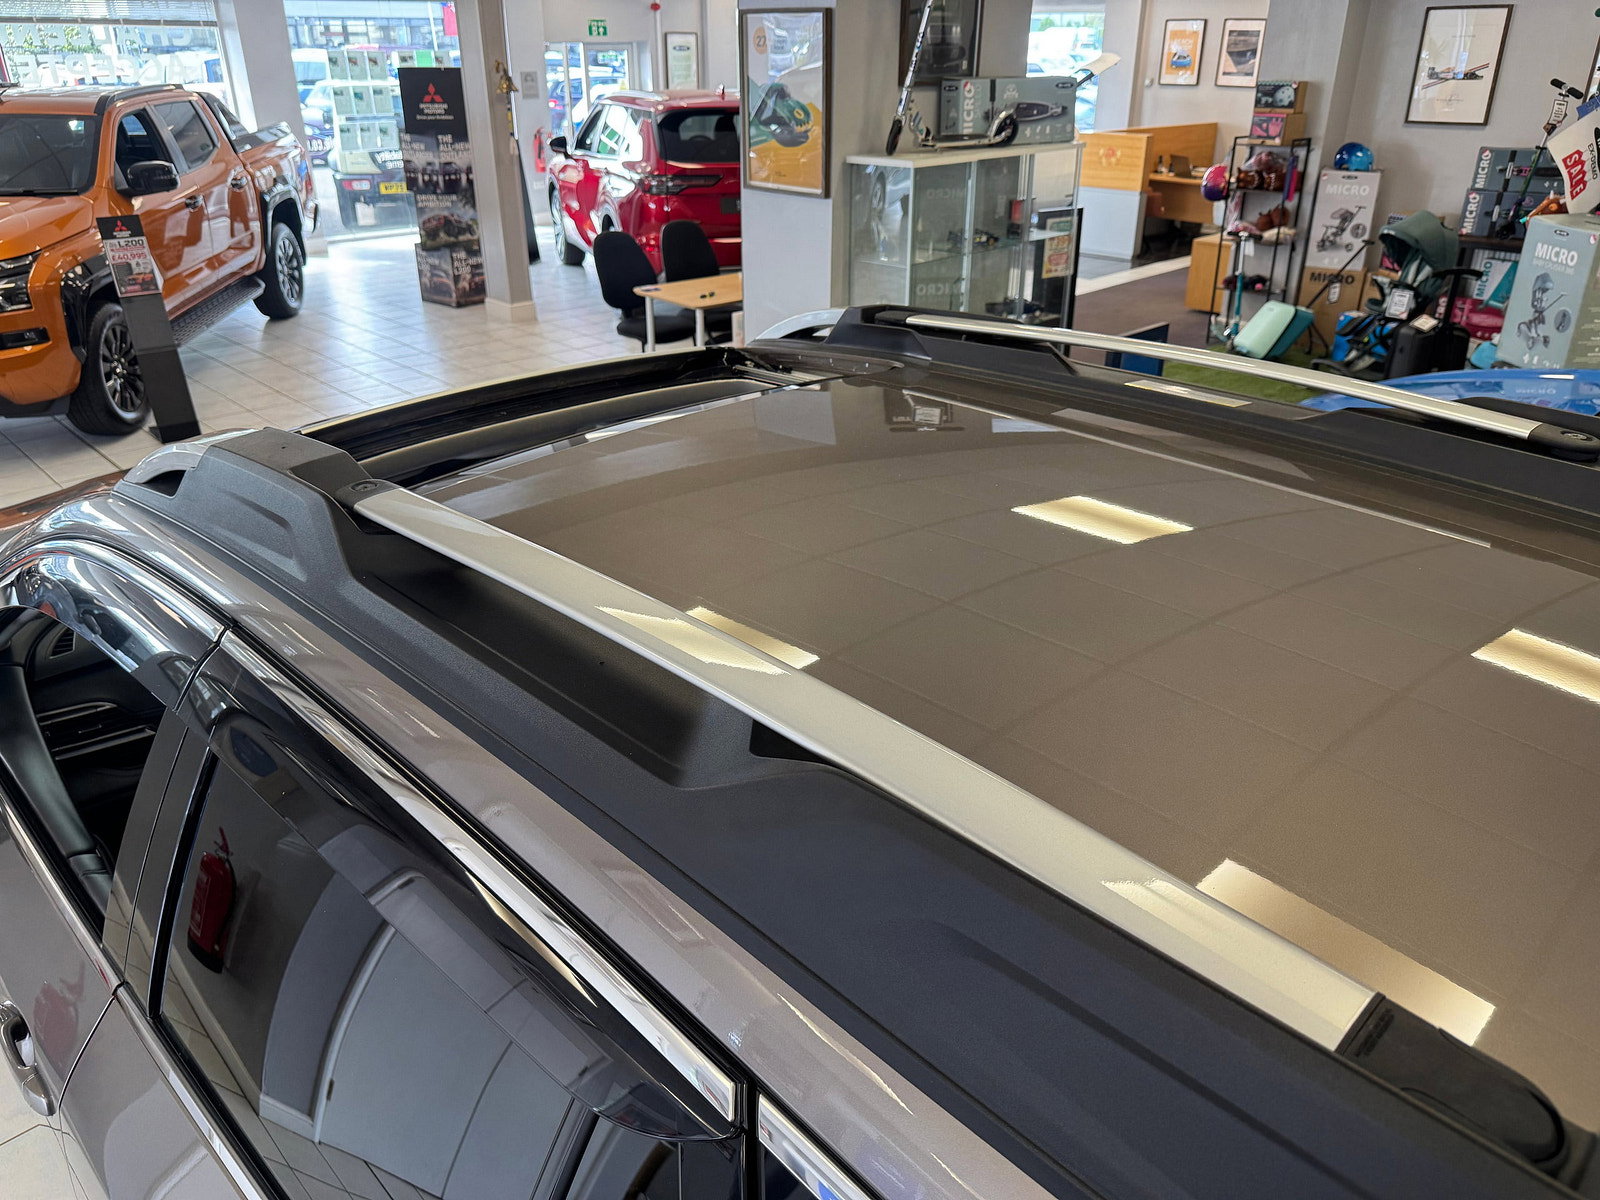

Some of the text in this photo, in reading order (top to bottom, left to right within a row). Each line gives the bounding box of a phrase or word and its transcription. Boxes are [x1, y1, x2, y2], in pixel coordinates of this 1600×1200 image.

[438, 134, 453, 143] THE
[1566, 153, 1584, 196] SALE
[1587, 142, 1598, 180] EX-DEMO
[1325, 184, 1370, 196] MICRO
[1463, 193, 1480, 234] MICRO
[1535, 242, 1578, 267] MICRO
